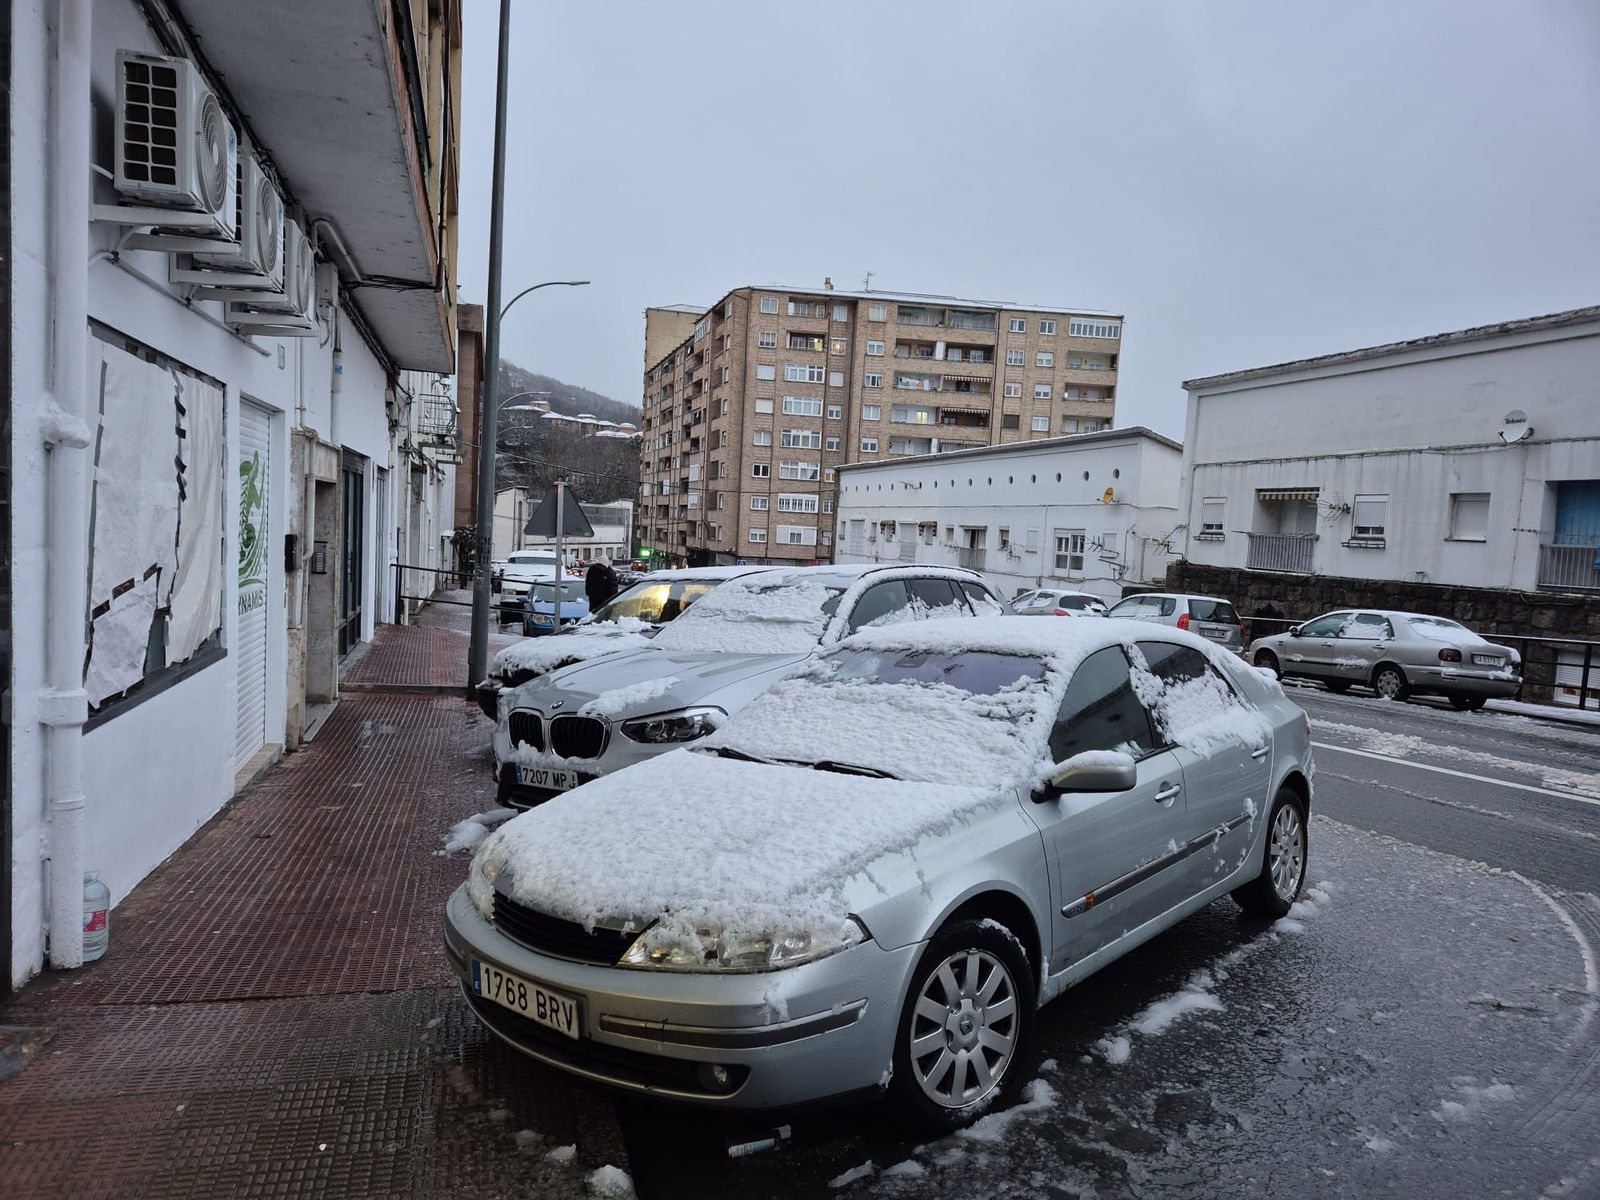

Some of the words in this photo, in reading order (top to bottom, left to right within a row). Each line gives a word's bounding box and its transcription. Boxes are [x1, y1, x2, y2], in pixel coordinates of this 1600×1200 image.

[522, 767, 549, 785] 7207
[484, 967, 528, 1012] 1768
[535, 989, 573, 1032] BRV
